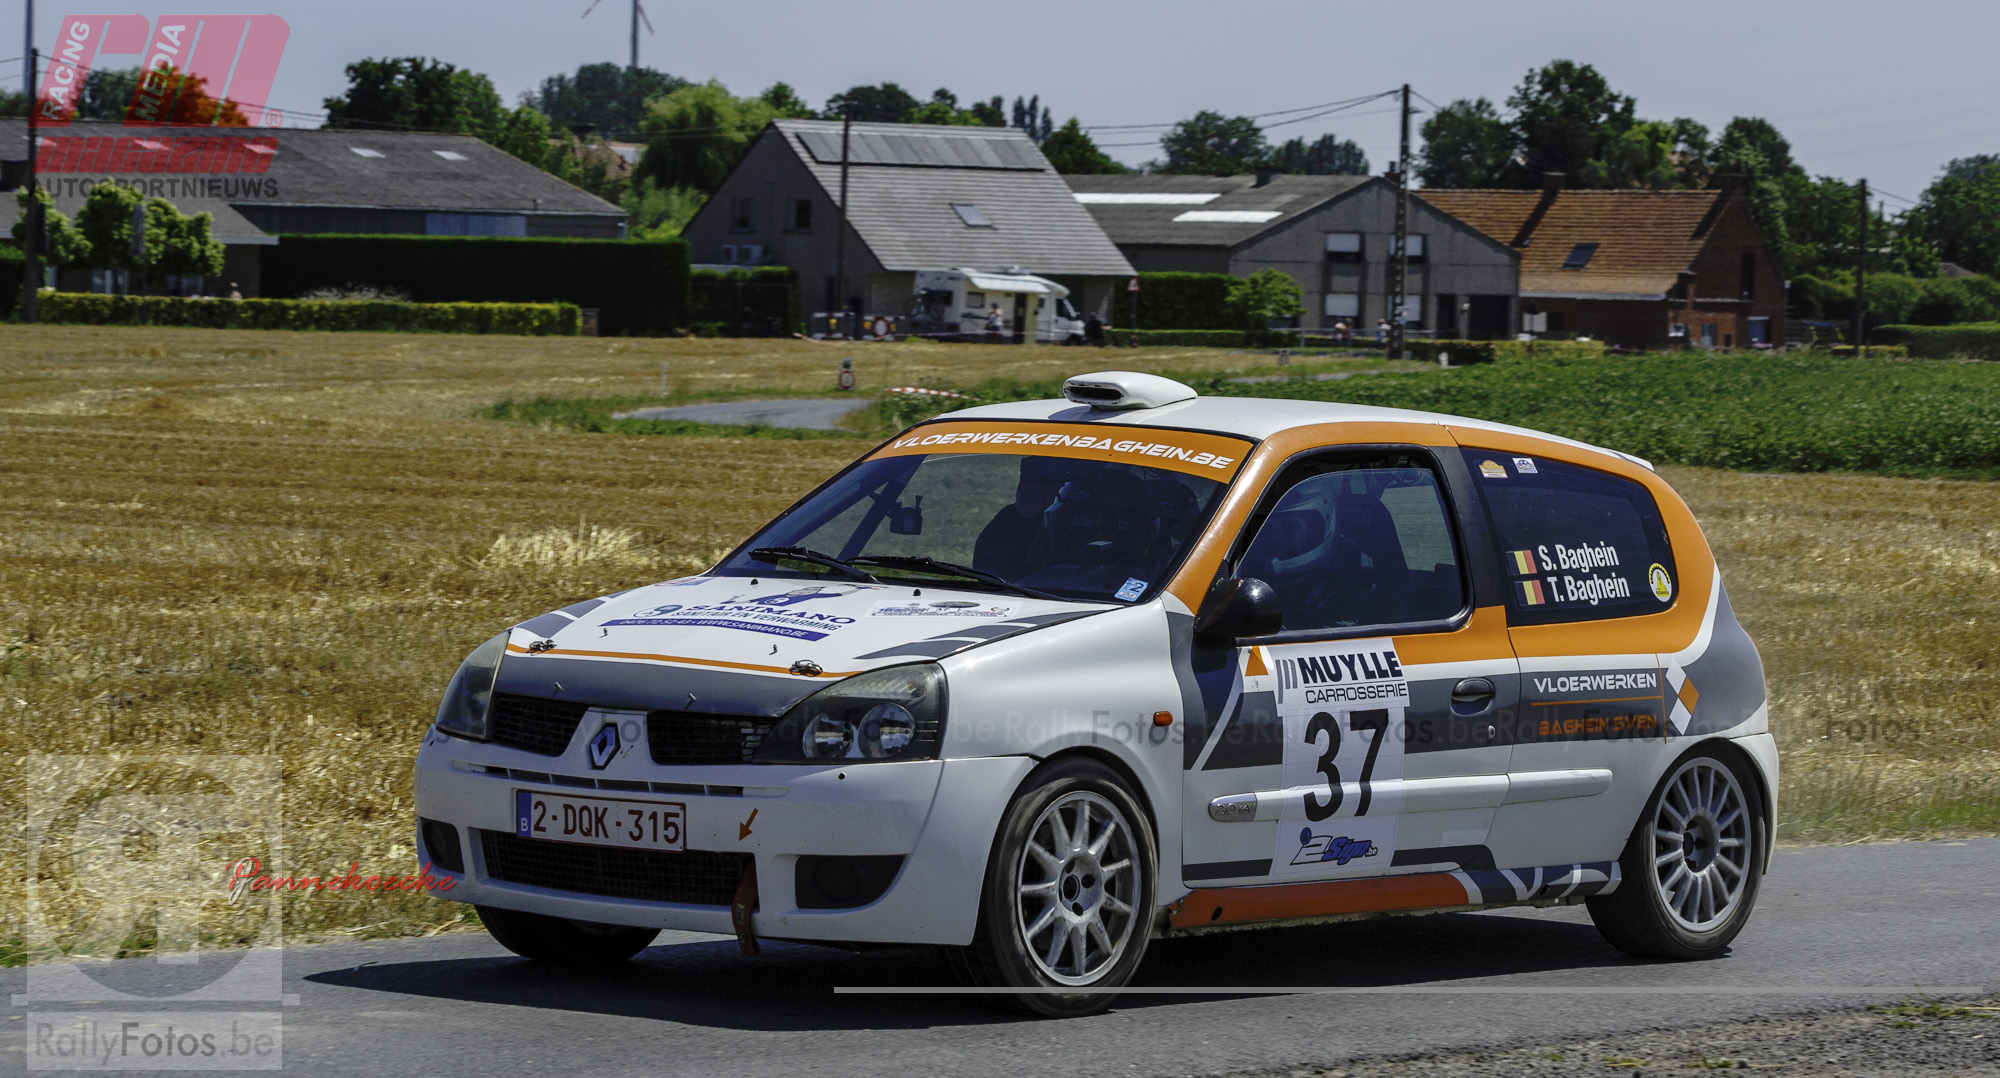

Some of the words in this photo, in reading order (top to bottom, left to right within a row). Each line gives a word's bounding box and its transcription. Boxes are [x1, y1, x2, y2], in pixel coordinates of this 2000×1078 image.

[893, 433, 1234, 470] VLOERWERKENBAGHEIN.BE
[1538, 545, 1557, 571] S.
[1559, 541, 1619, 573] Baghein
[1547, 576, 1565, 602] T.
[1567, 572, 1630, 605] Baghein
[686, 605, 856, 624] SANIMANO
[752, 613, 842, 631] VERWARMING
[1301, 651, 1403, 684] MUYLLE
[1305, 682, 1408, 704] CARROSSERIE
[1533, 673, 1657, 693] VLOERWERKEN
[1538, 718, 1609, 735] BAGHEIN
[1613, 714, 1658, 731] SVEN
[1303, 708, 1389, 822] 37
[520, 818, 529, 832] B
